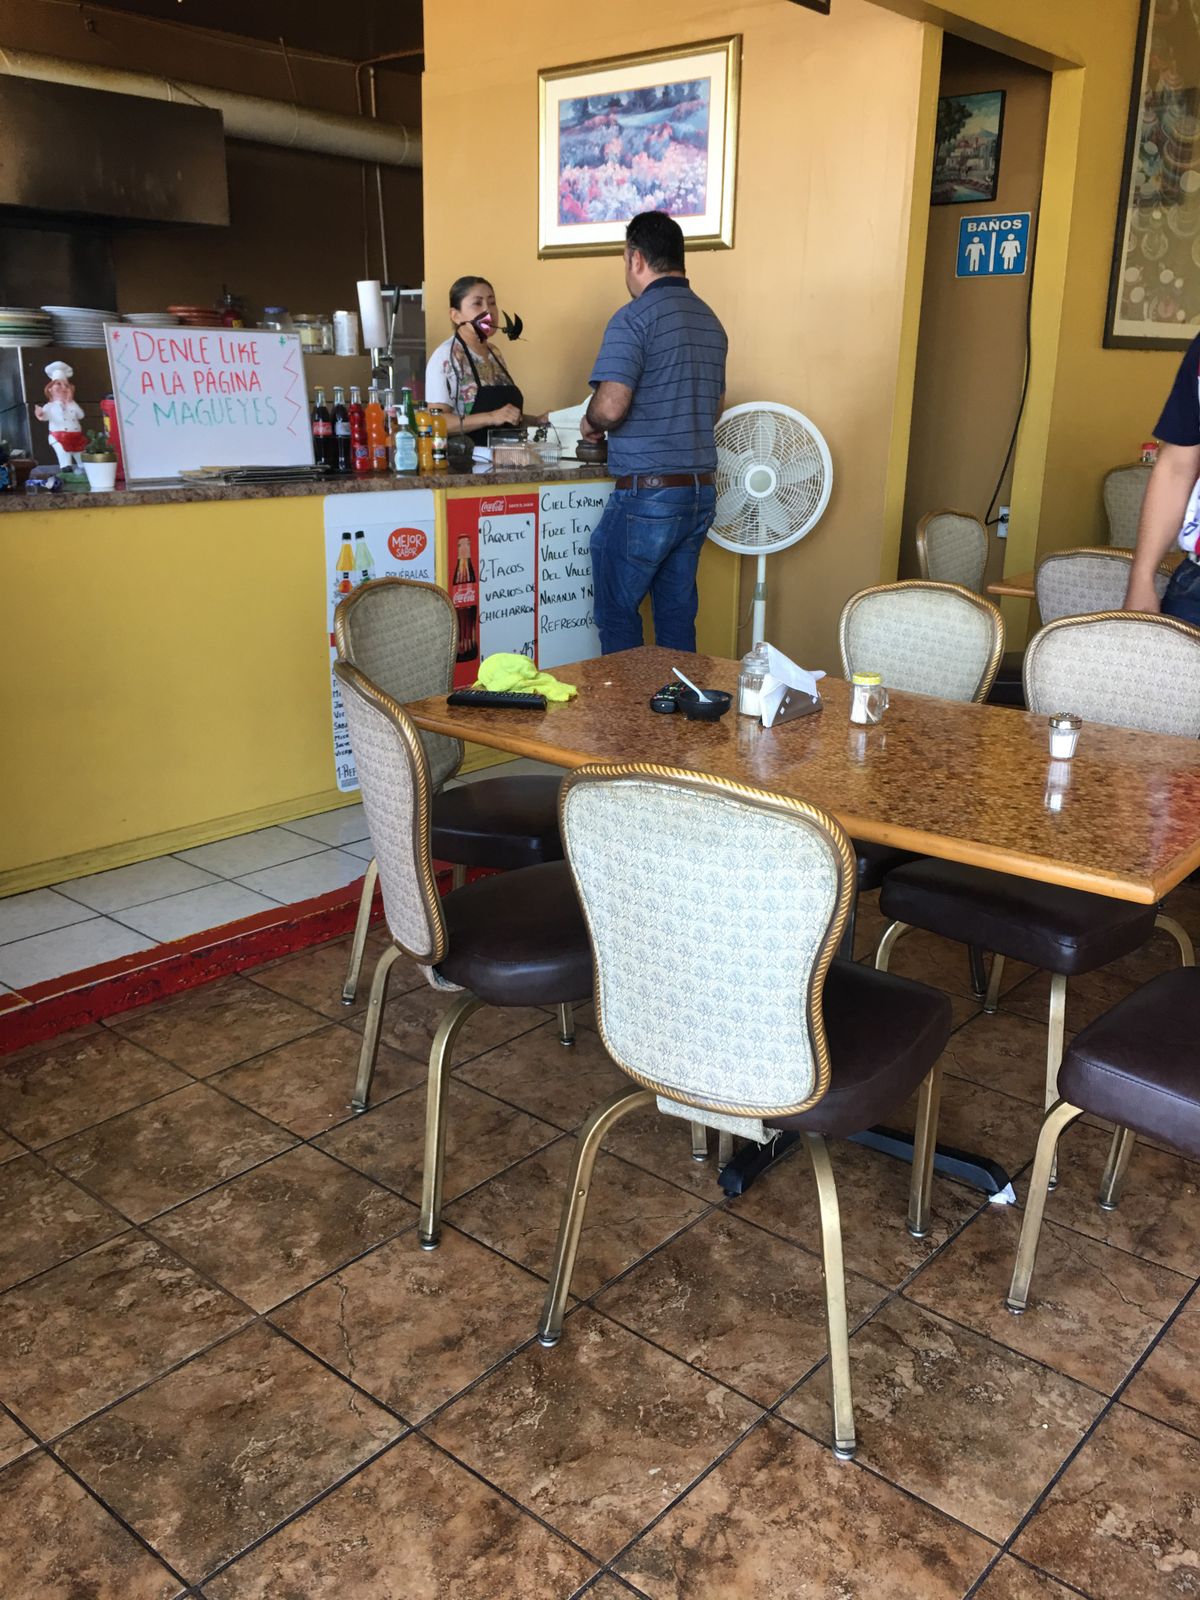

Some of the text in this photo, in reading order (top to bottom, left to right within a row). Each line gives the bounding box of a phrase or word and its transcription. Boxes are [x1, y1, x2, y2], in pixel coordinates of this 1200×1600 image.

[967, 217, 1022, 232] BAÑOS
[132, 331, 261, 366] DENLE LIKE
[141, 367, 262, 396] A LA PÁGINA
[152, 396, 278, 427] MAGUEYES
[541, 492, 567, 513] CIEL
[542, 518, 592, 540] FUZE TEA
[391, 533, 424, 549] MEJOR
[396, 547, 417, 558] SABOR
[540, 546, 569, 563] VALLE
[541, 562, 592, 582] DEL VALLE
[485, 587, 523, 602] VARIOS
[539, 592, 577, 606] NARANJA
